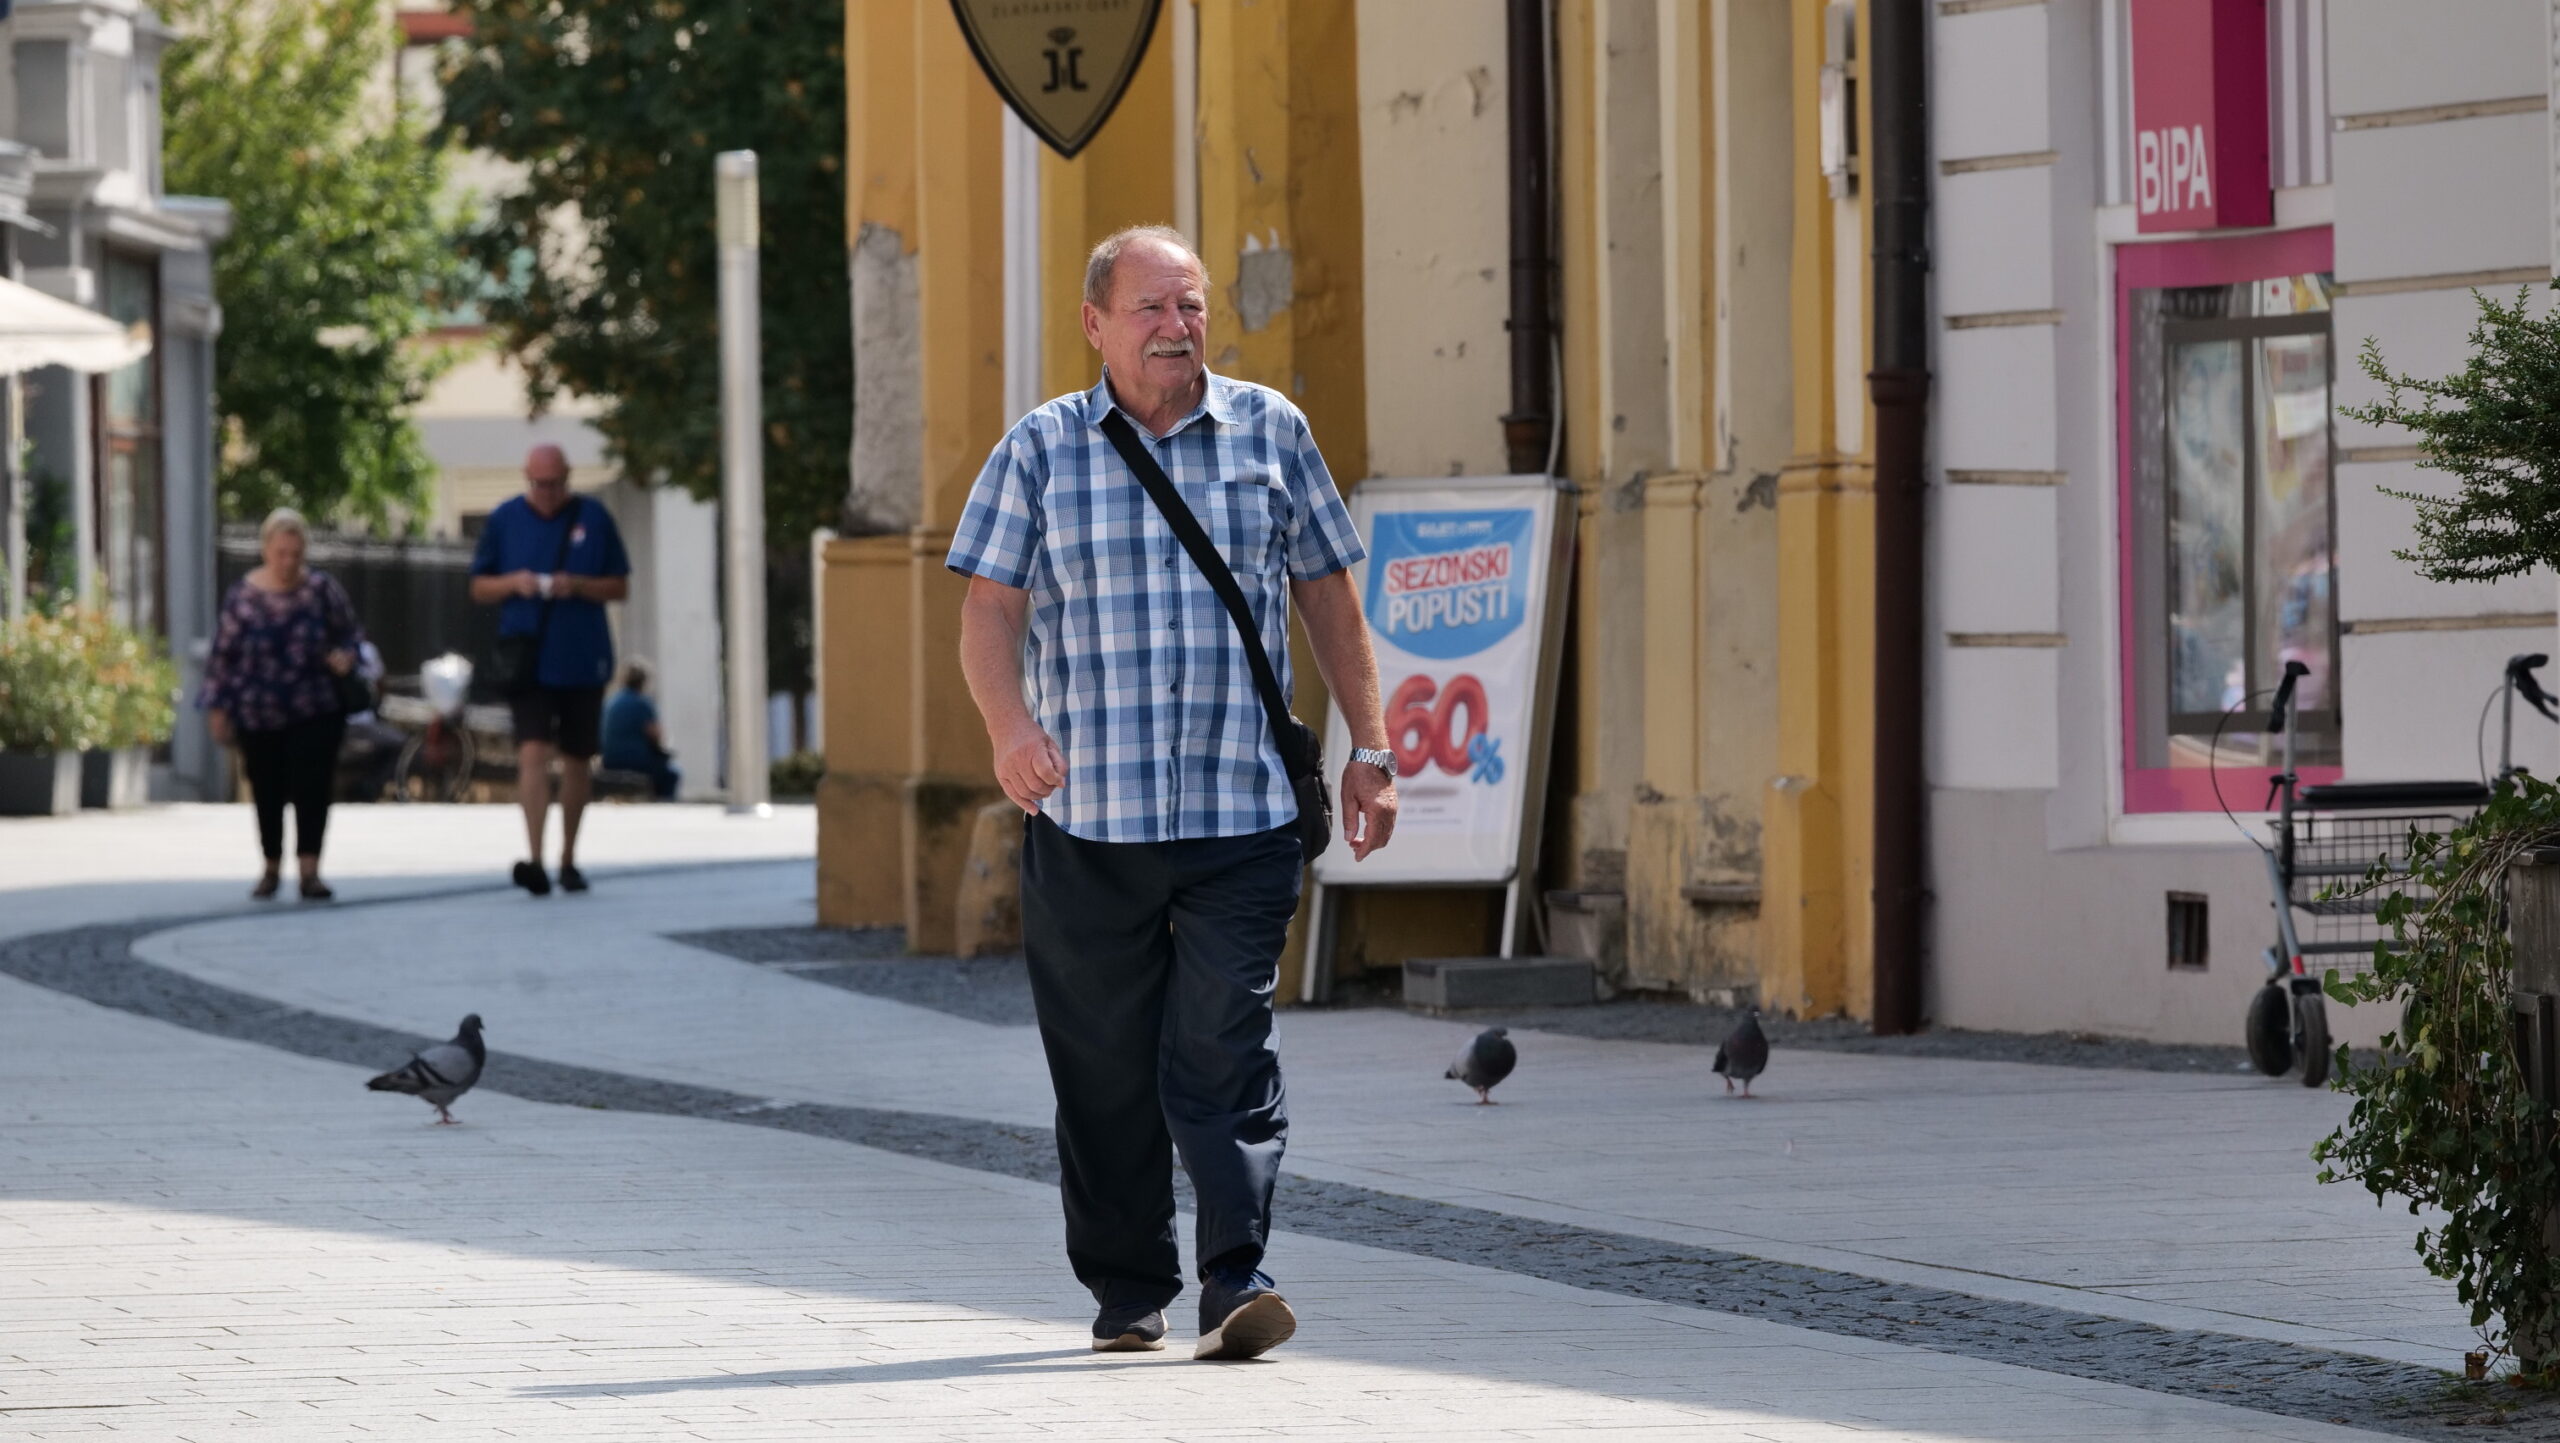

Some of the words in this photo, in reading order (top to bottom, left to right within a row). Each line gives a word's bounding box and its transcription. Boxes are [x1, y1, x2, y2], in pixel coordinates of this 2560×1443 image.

[2139, 124, 2213, 215] BIPA
[1385, 544, 1510, 596] SEZONSKI
[1386, 584, 1510, 636] POPUSTI
